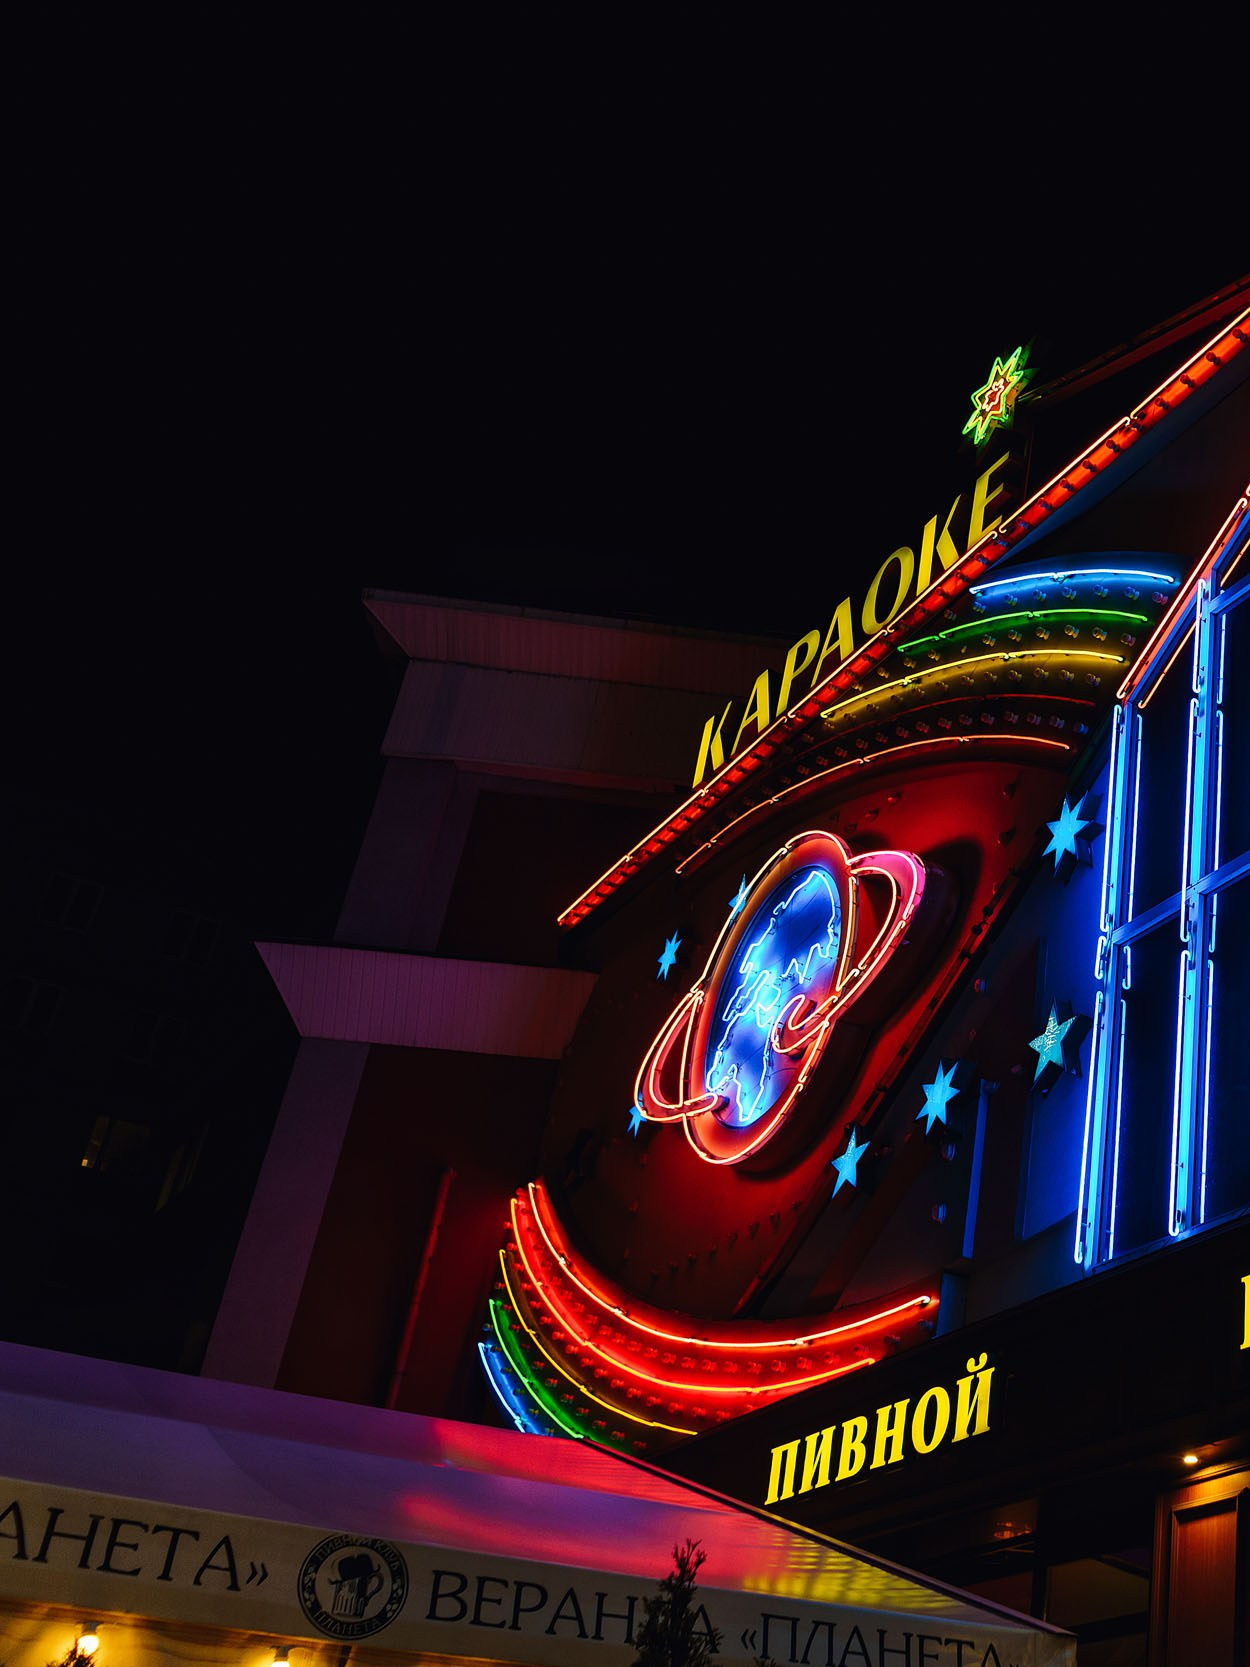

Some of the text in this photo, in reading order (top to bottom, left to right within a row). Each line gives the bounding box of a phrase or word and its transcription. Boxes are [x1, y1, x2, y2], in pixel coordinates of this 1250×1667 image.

[692, 451, 1010, 789] КАРАОКЕ
[764, 1352, 996, 1505] ПИВНОЙ
[426, 1570, 719, 1653] ВЕРАНА
